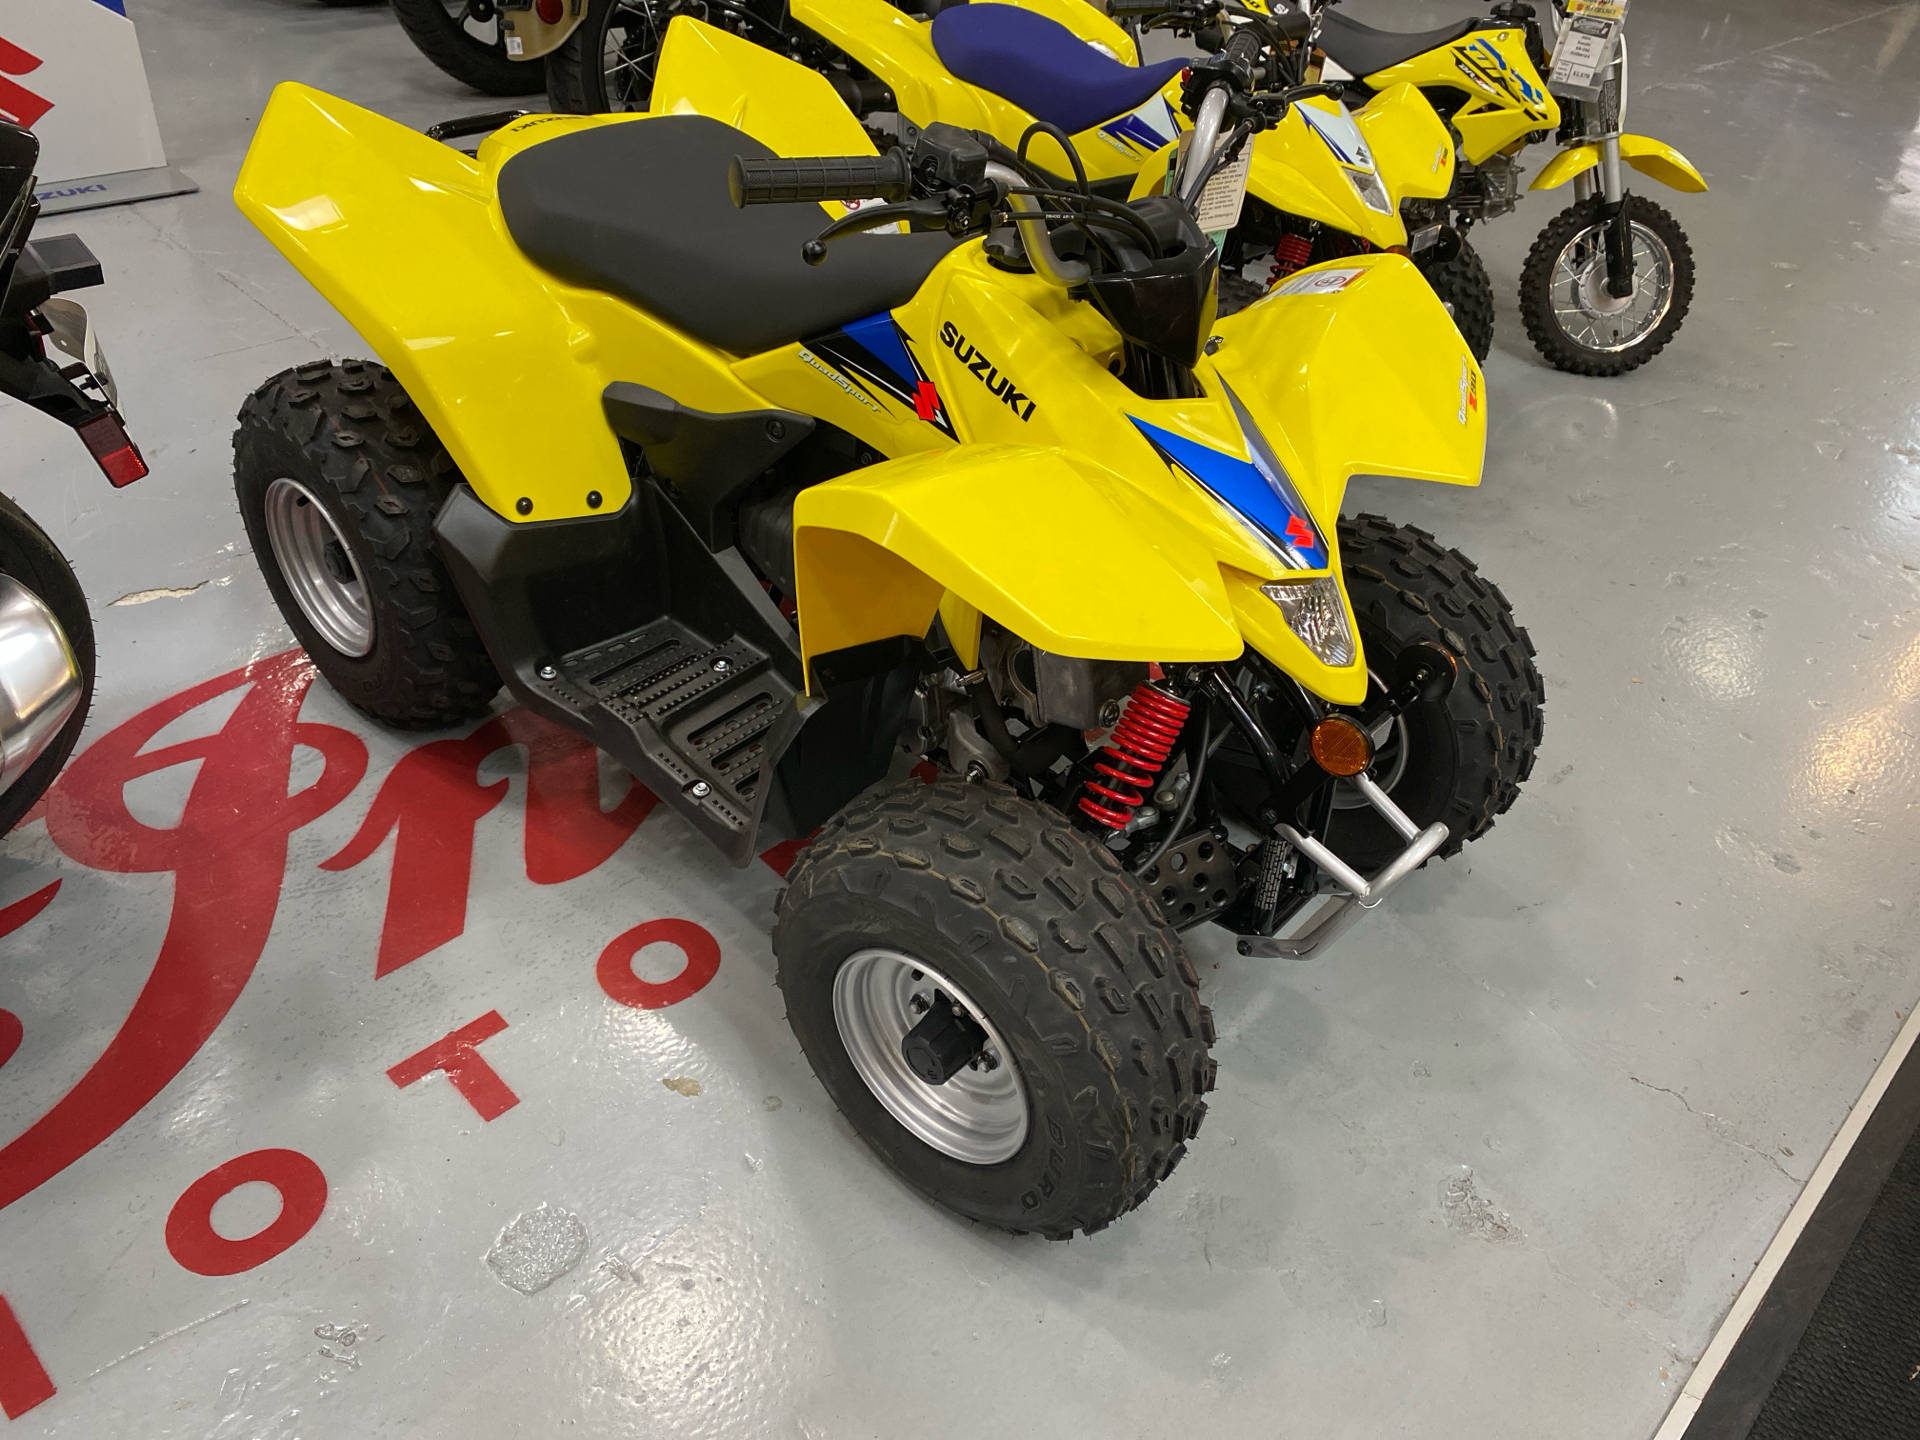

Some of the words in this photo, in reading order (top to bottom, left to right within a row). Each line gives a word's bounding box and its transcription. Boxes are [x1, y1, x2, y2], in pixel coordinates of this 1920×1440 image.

[35, 184, 107, 200] ZUKI
[797, 349, 882, 413] QuadSport
[939, 320, 1037, 423] SUZUKI
[1457, 353, 1469, 426] QuadSport
[1020, 1114, 1067, 1211] DURO
